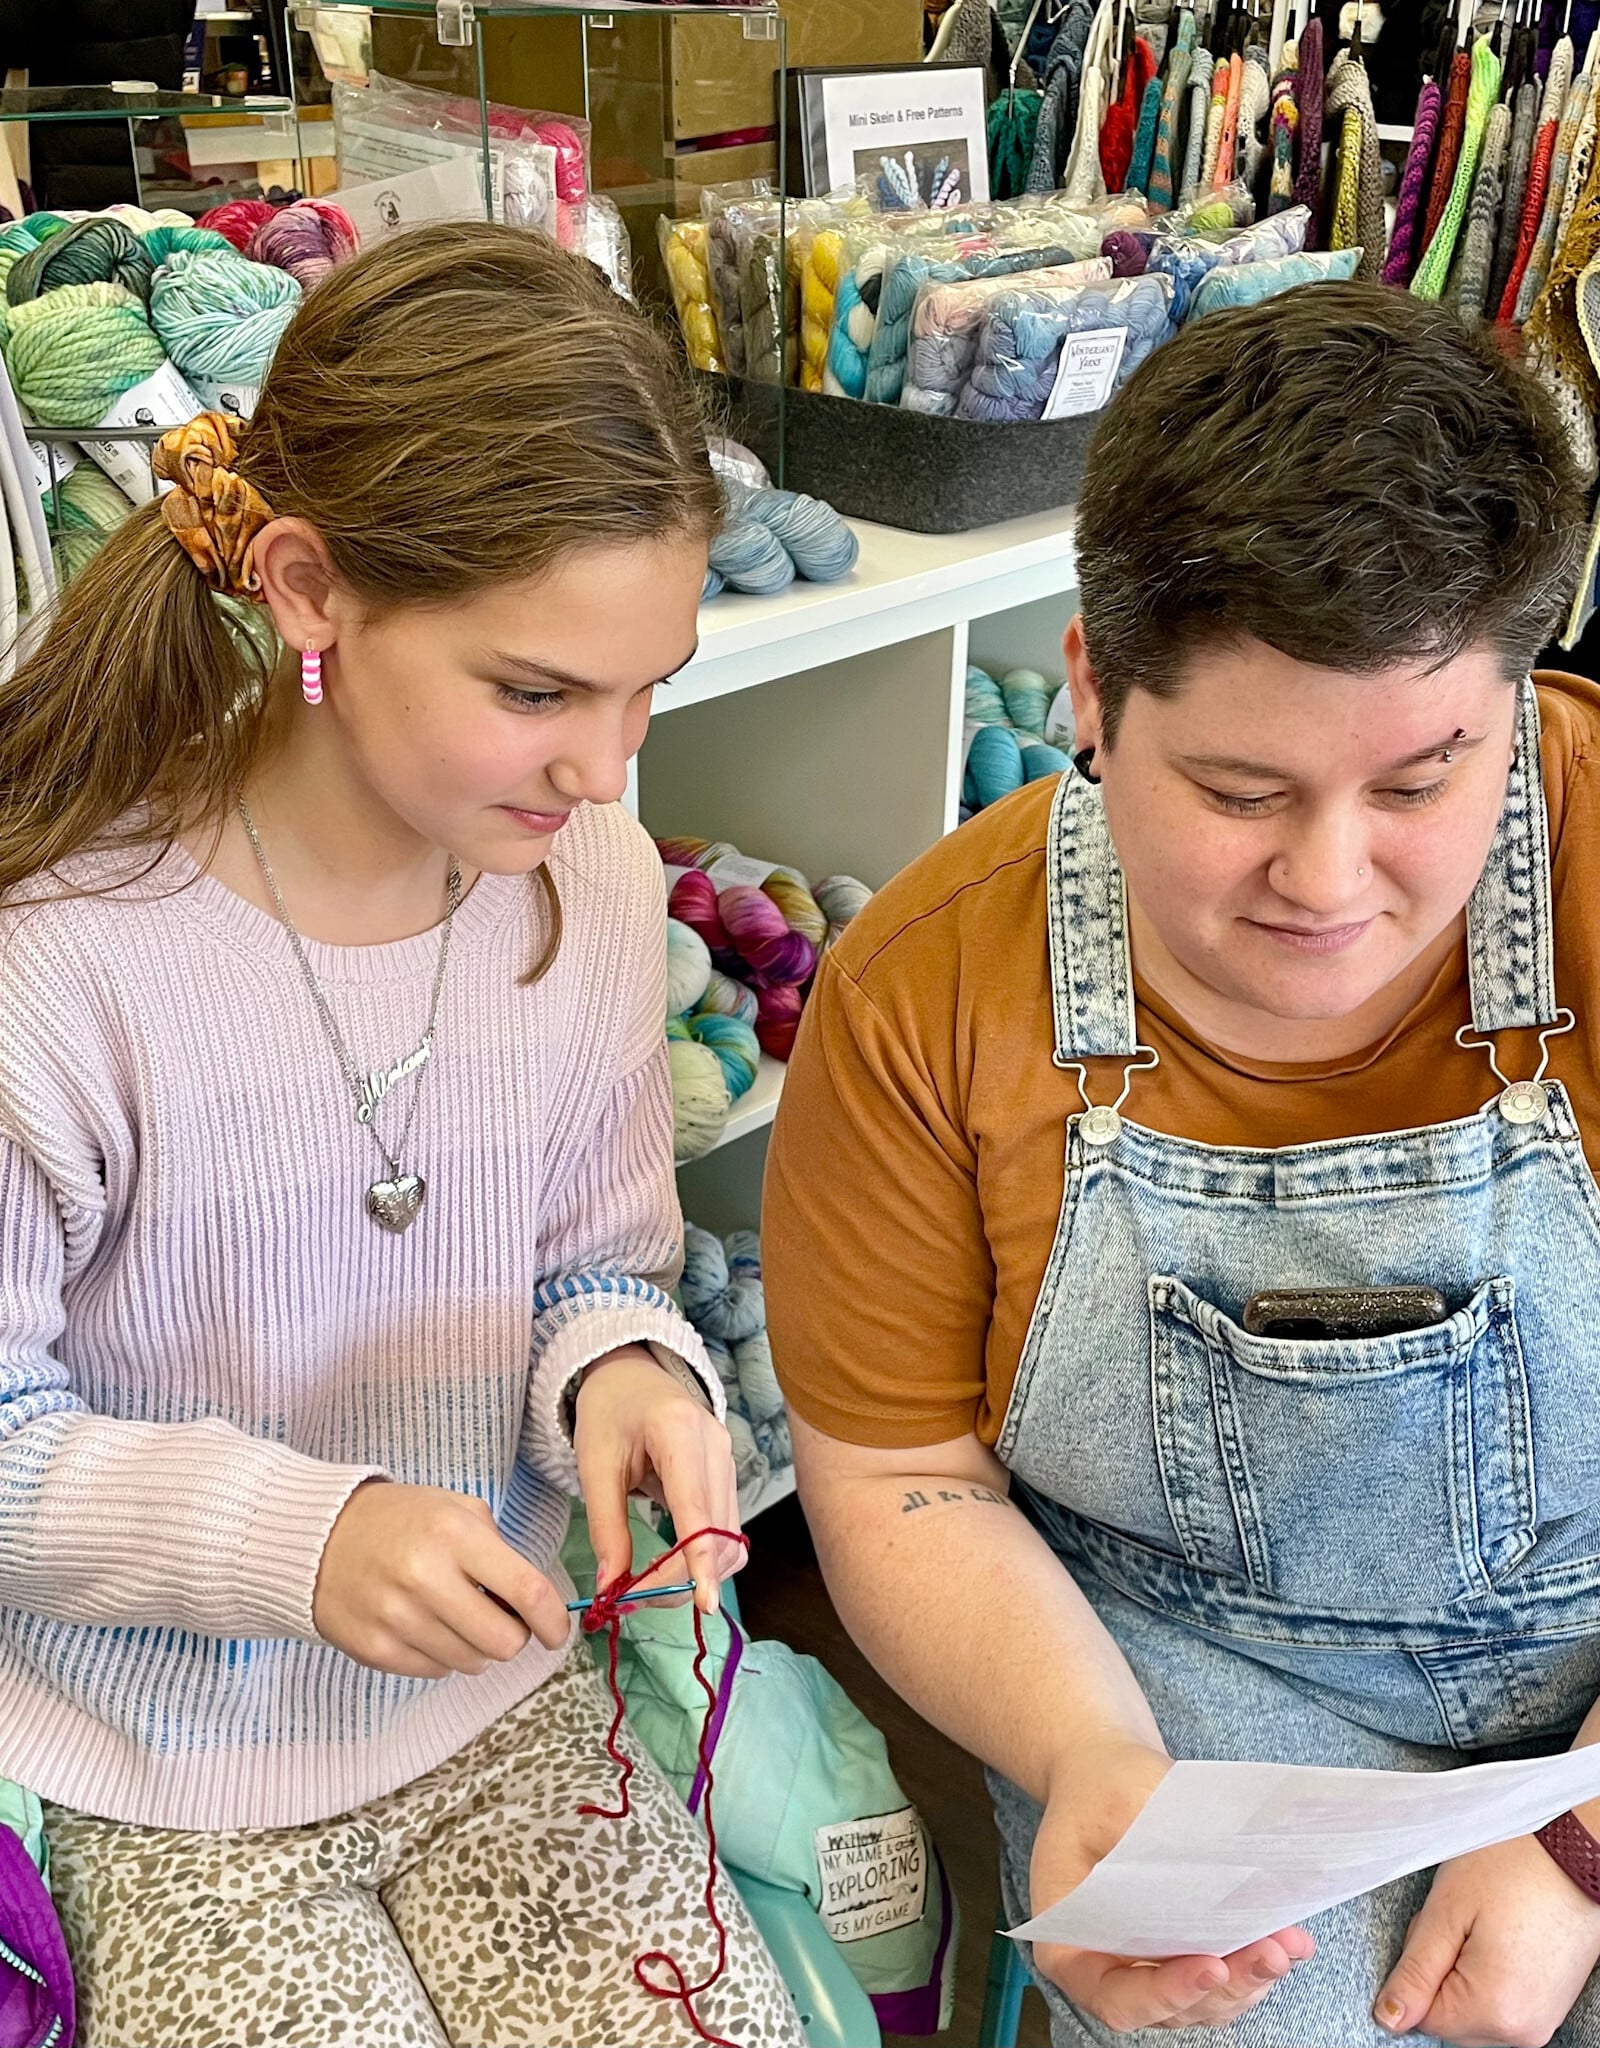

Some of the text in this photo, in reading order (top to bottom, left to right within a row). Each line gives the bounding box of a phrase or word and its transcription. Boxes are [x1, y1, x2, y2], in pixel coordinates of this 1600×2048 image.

[848, 106, 963, 127] Mini Skein & Free Patterns
[823, 1853, 841, 1871] MY
[847, 1845, 882, 1865] NAME
[829, 1848, 919, 1901] EXPLORING
[832, 1903, 910, 1935] IS MY GAME
